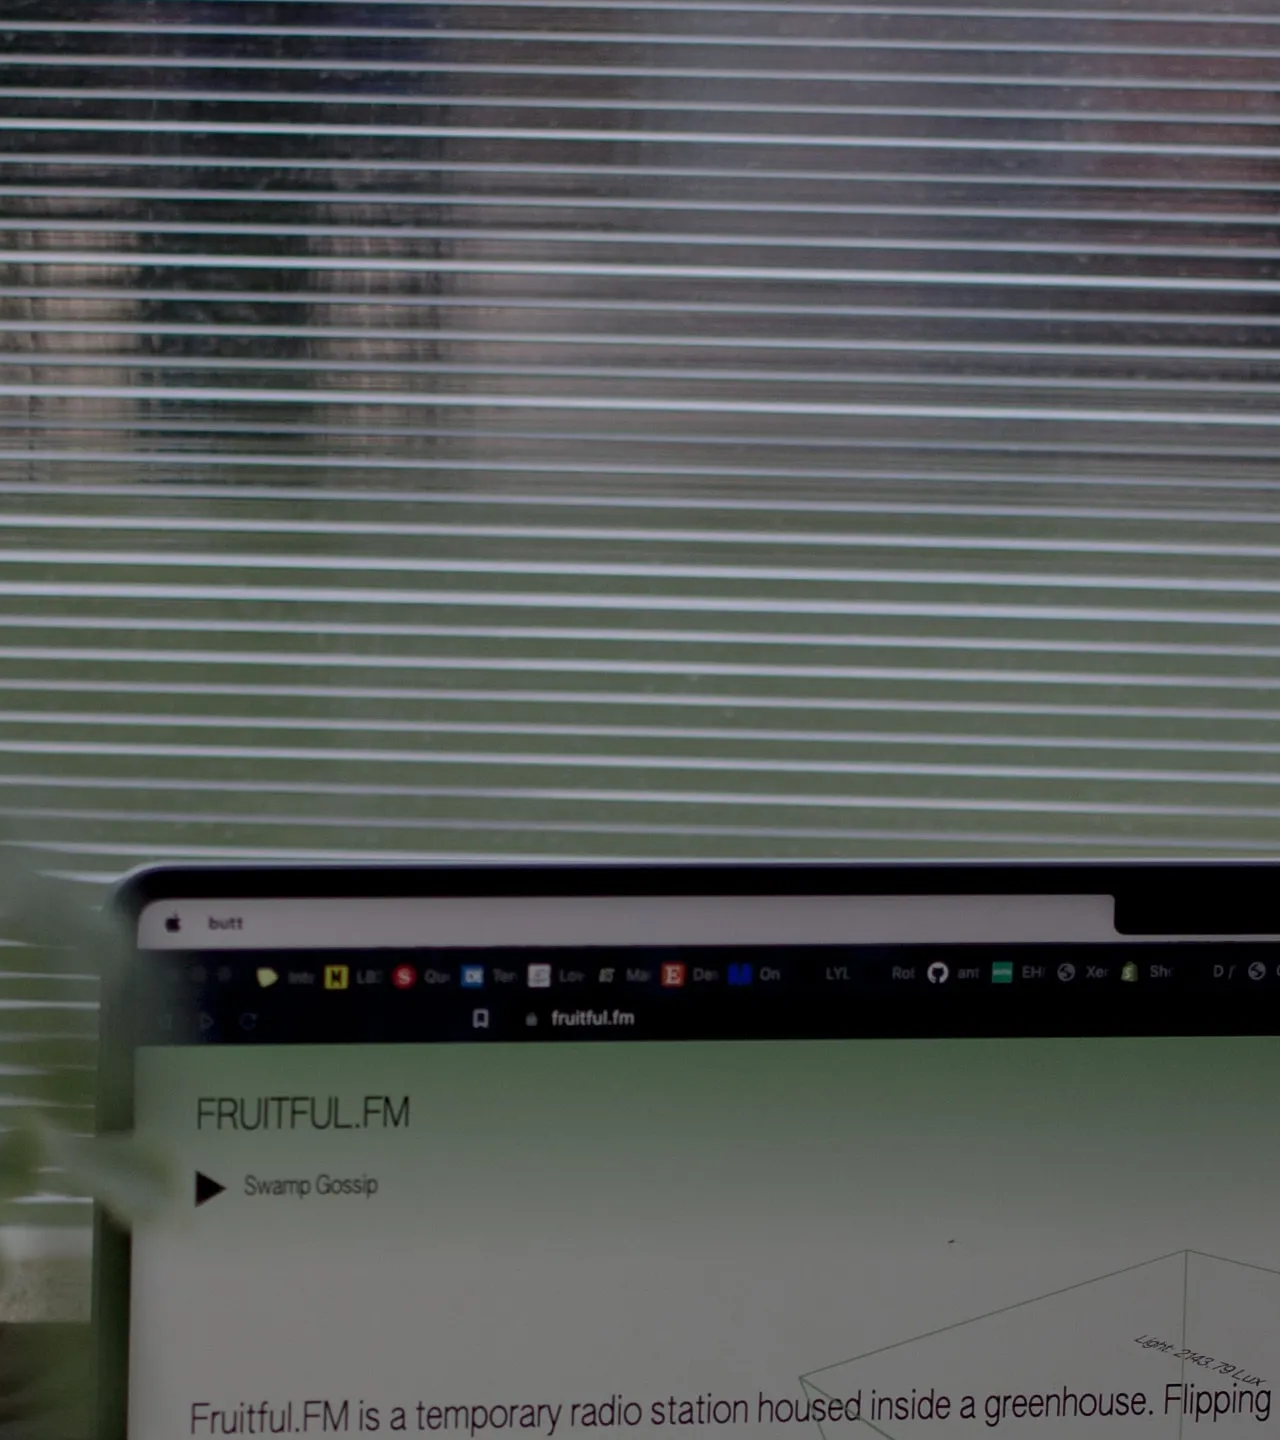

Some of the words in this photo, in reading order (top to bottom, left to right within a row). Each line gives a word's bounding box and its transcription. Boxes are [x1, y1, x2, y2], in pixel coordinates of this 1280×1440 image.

[207, 916, 244, 931] butt
[551, 1009, 635, 1026] fruitful.fm
[197, 1095, 410, 1131] FRUITFUL.FM
[244, 1174, 312, 1199] Swamp
[315, 1173, 379, 1199] Gossip
[1231, 1368, 1267, 1387] Lux
[191, 1399, 349, 1435] Fruitful.FM
[359, 1399, 380, 1432] is
[390, 1406, 407, 1431] a
[415, 1401, 562, 1438] temporary
[571, 1394, 643, 1427] radio
[650, 1392, 749, 1426] station
[758, 1389, 862, 1423] housed
[871, 1387, 951, 1421] inside
[959, 1395, 977, 1419] a
[984, 1385, 1154, 1428] greenhouse.
[1164, 1381, 1272, 1424] Flipping
